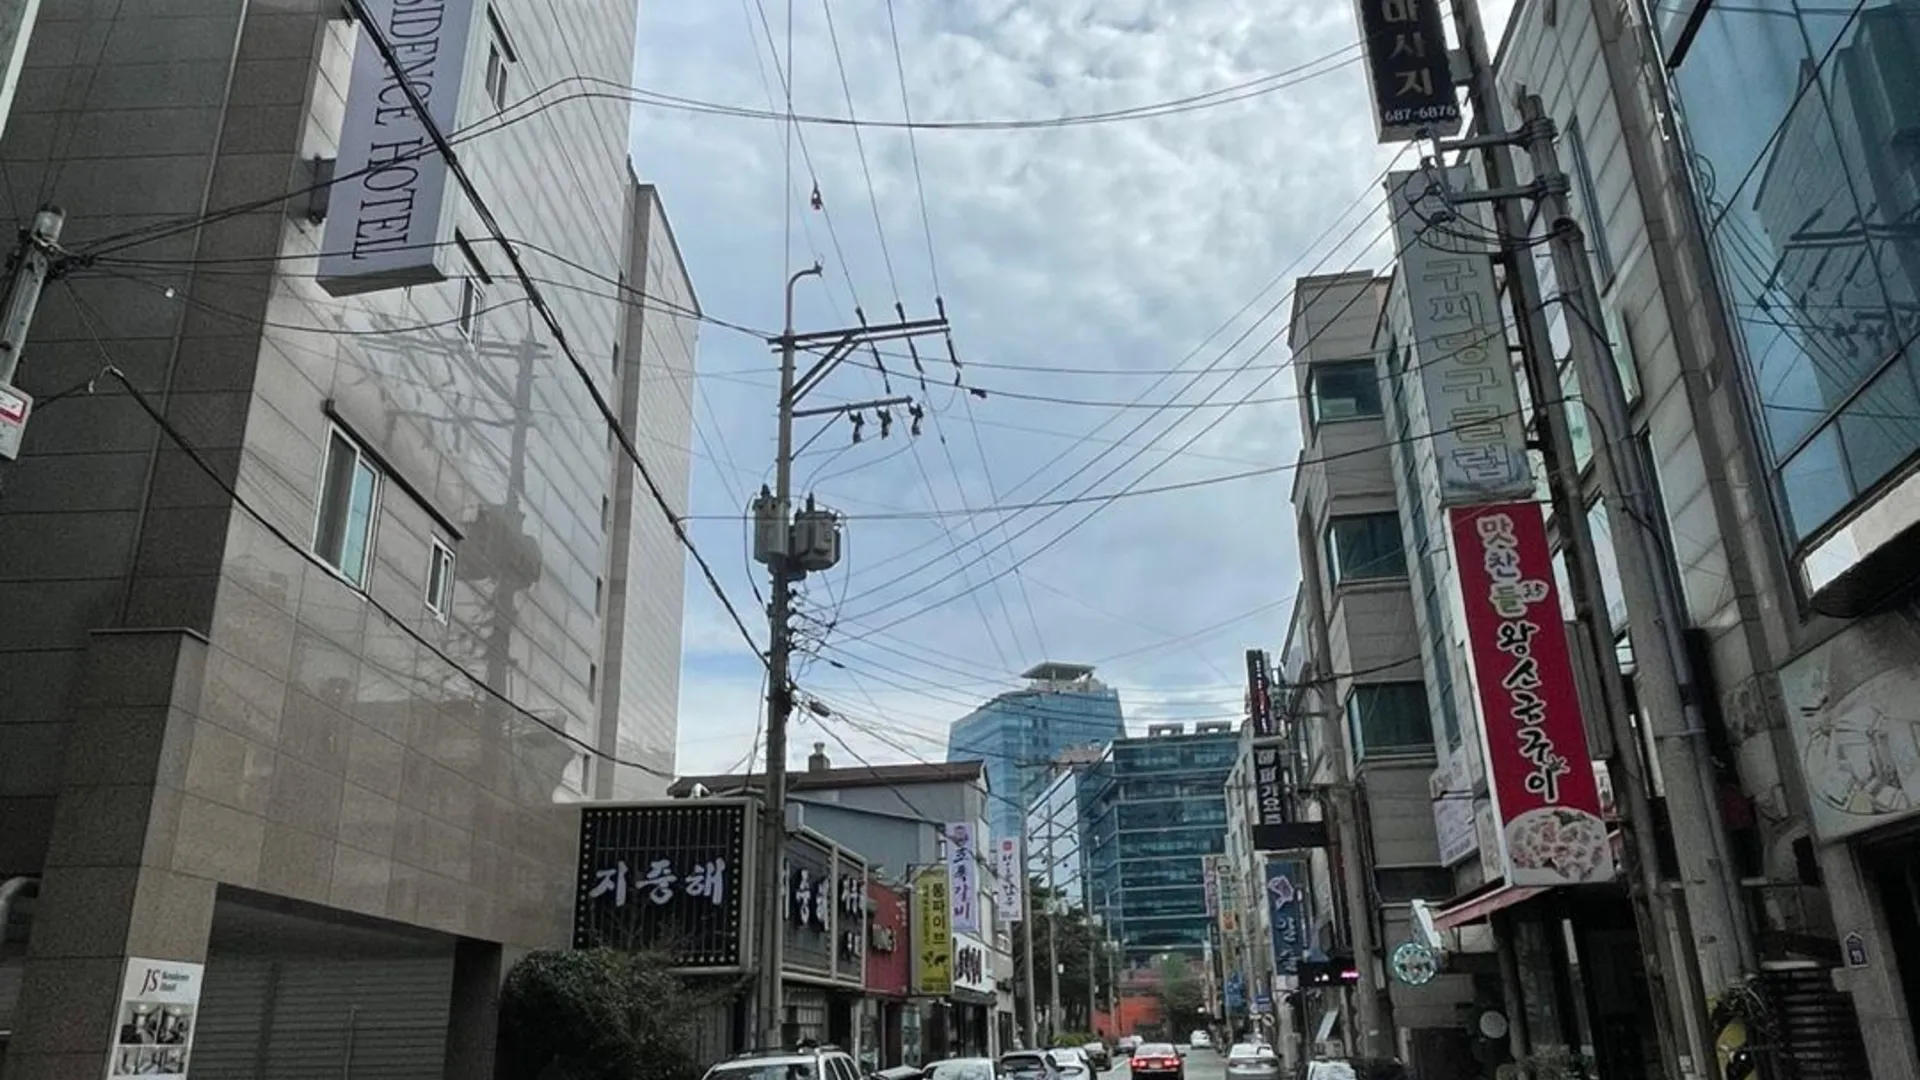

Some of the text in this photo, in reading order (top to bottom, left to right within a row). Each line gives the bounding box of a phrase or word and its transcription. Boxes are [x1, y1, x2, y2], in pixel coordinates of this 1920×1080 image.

[1385, 106, 1457, 122] 687-6876
[353, 136, 424, 261] HOTEL
[588, 857, 726, 907] 지중해
